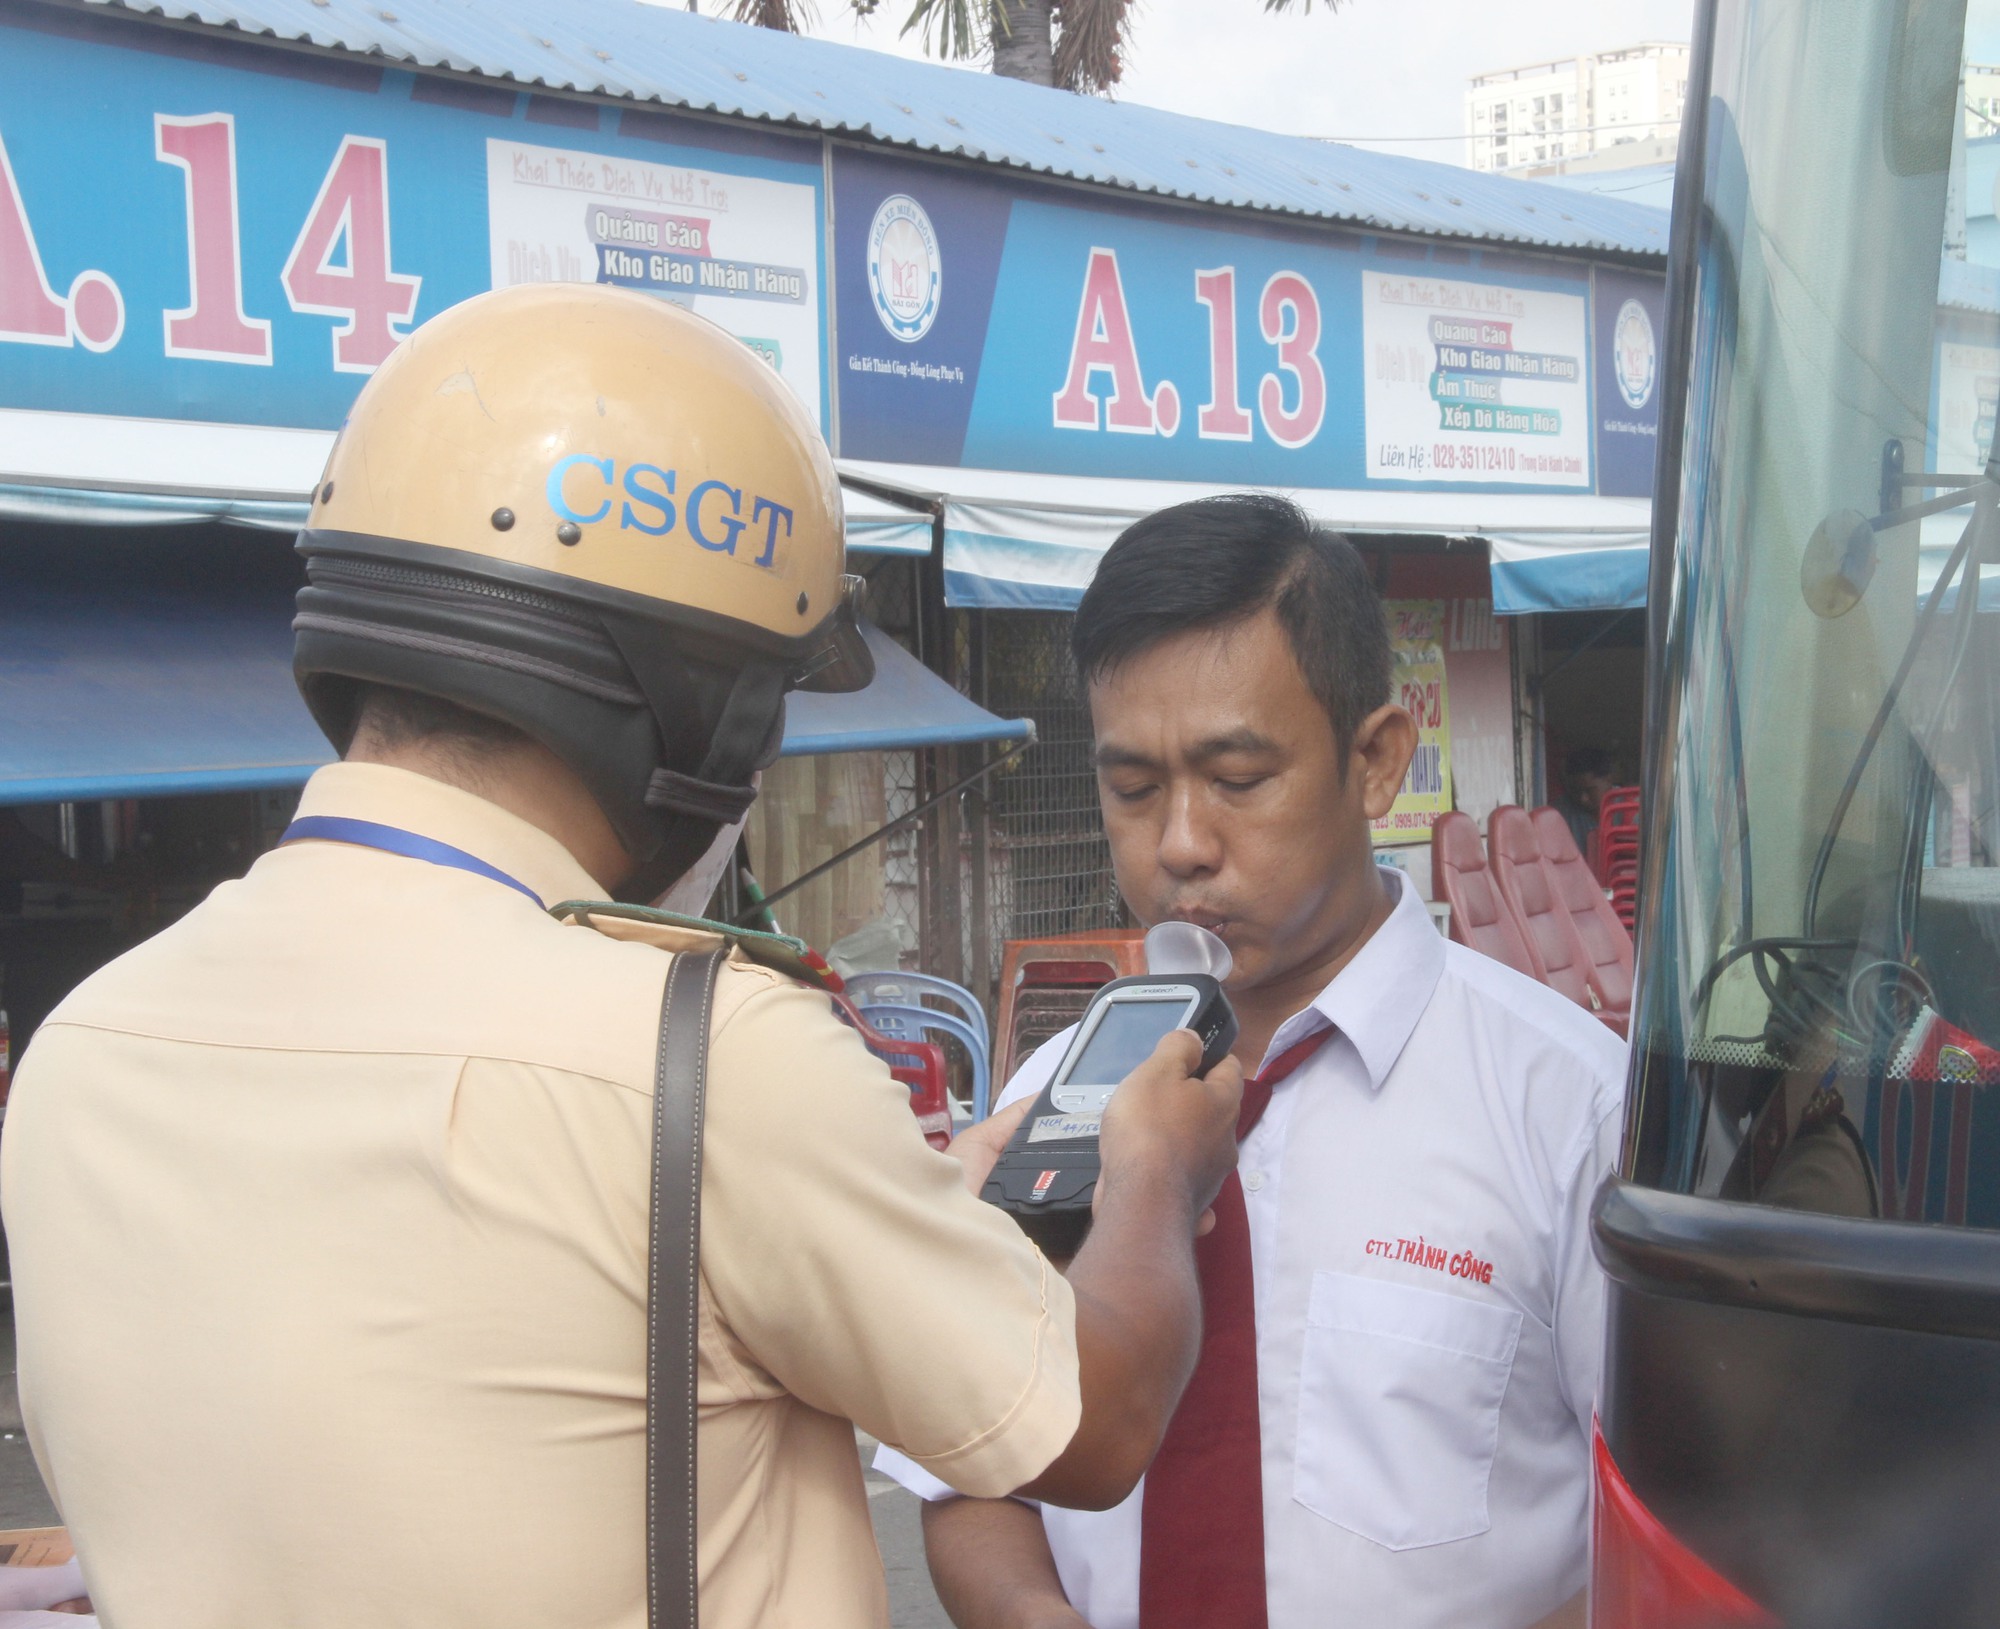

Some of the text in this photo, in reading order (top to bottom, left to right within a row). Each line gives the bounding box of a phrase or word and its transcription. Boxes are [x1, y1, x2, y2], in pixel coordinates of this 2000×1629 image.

[512, 151, 549, 182] Khai
[595, 207, 702, 249] Quảng Cáo
[604, 249, 801, 300] Kho Giao Nhận Hàng
[1053, 246, 1326, 449] A.13
[1440, 347, 1467, 368] Kho
[1471, 351, 1501, 371] Giao
[1505, 354, 1539, 377] Nhận
[1445, 405, 1471, 429] Xếp
[1380, 443, 1405, 468] Liên
[546, 453, 794, 568] CSGT
[1449, 1250, 1494, 1285] CÔNG
